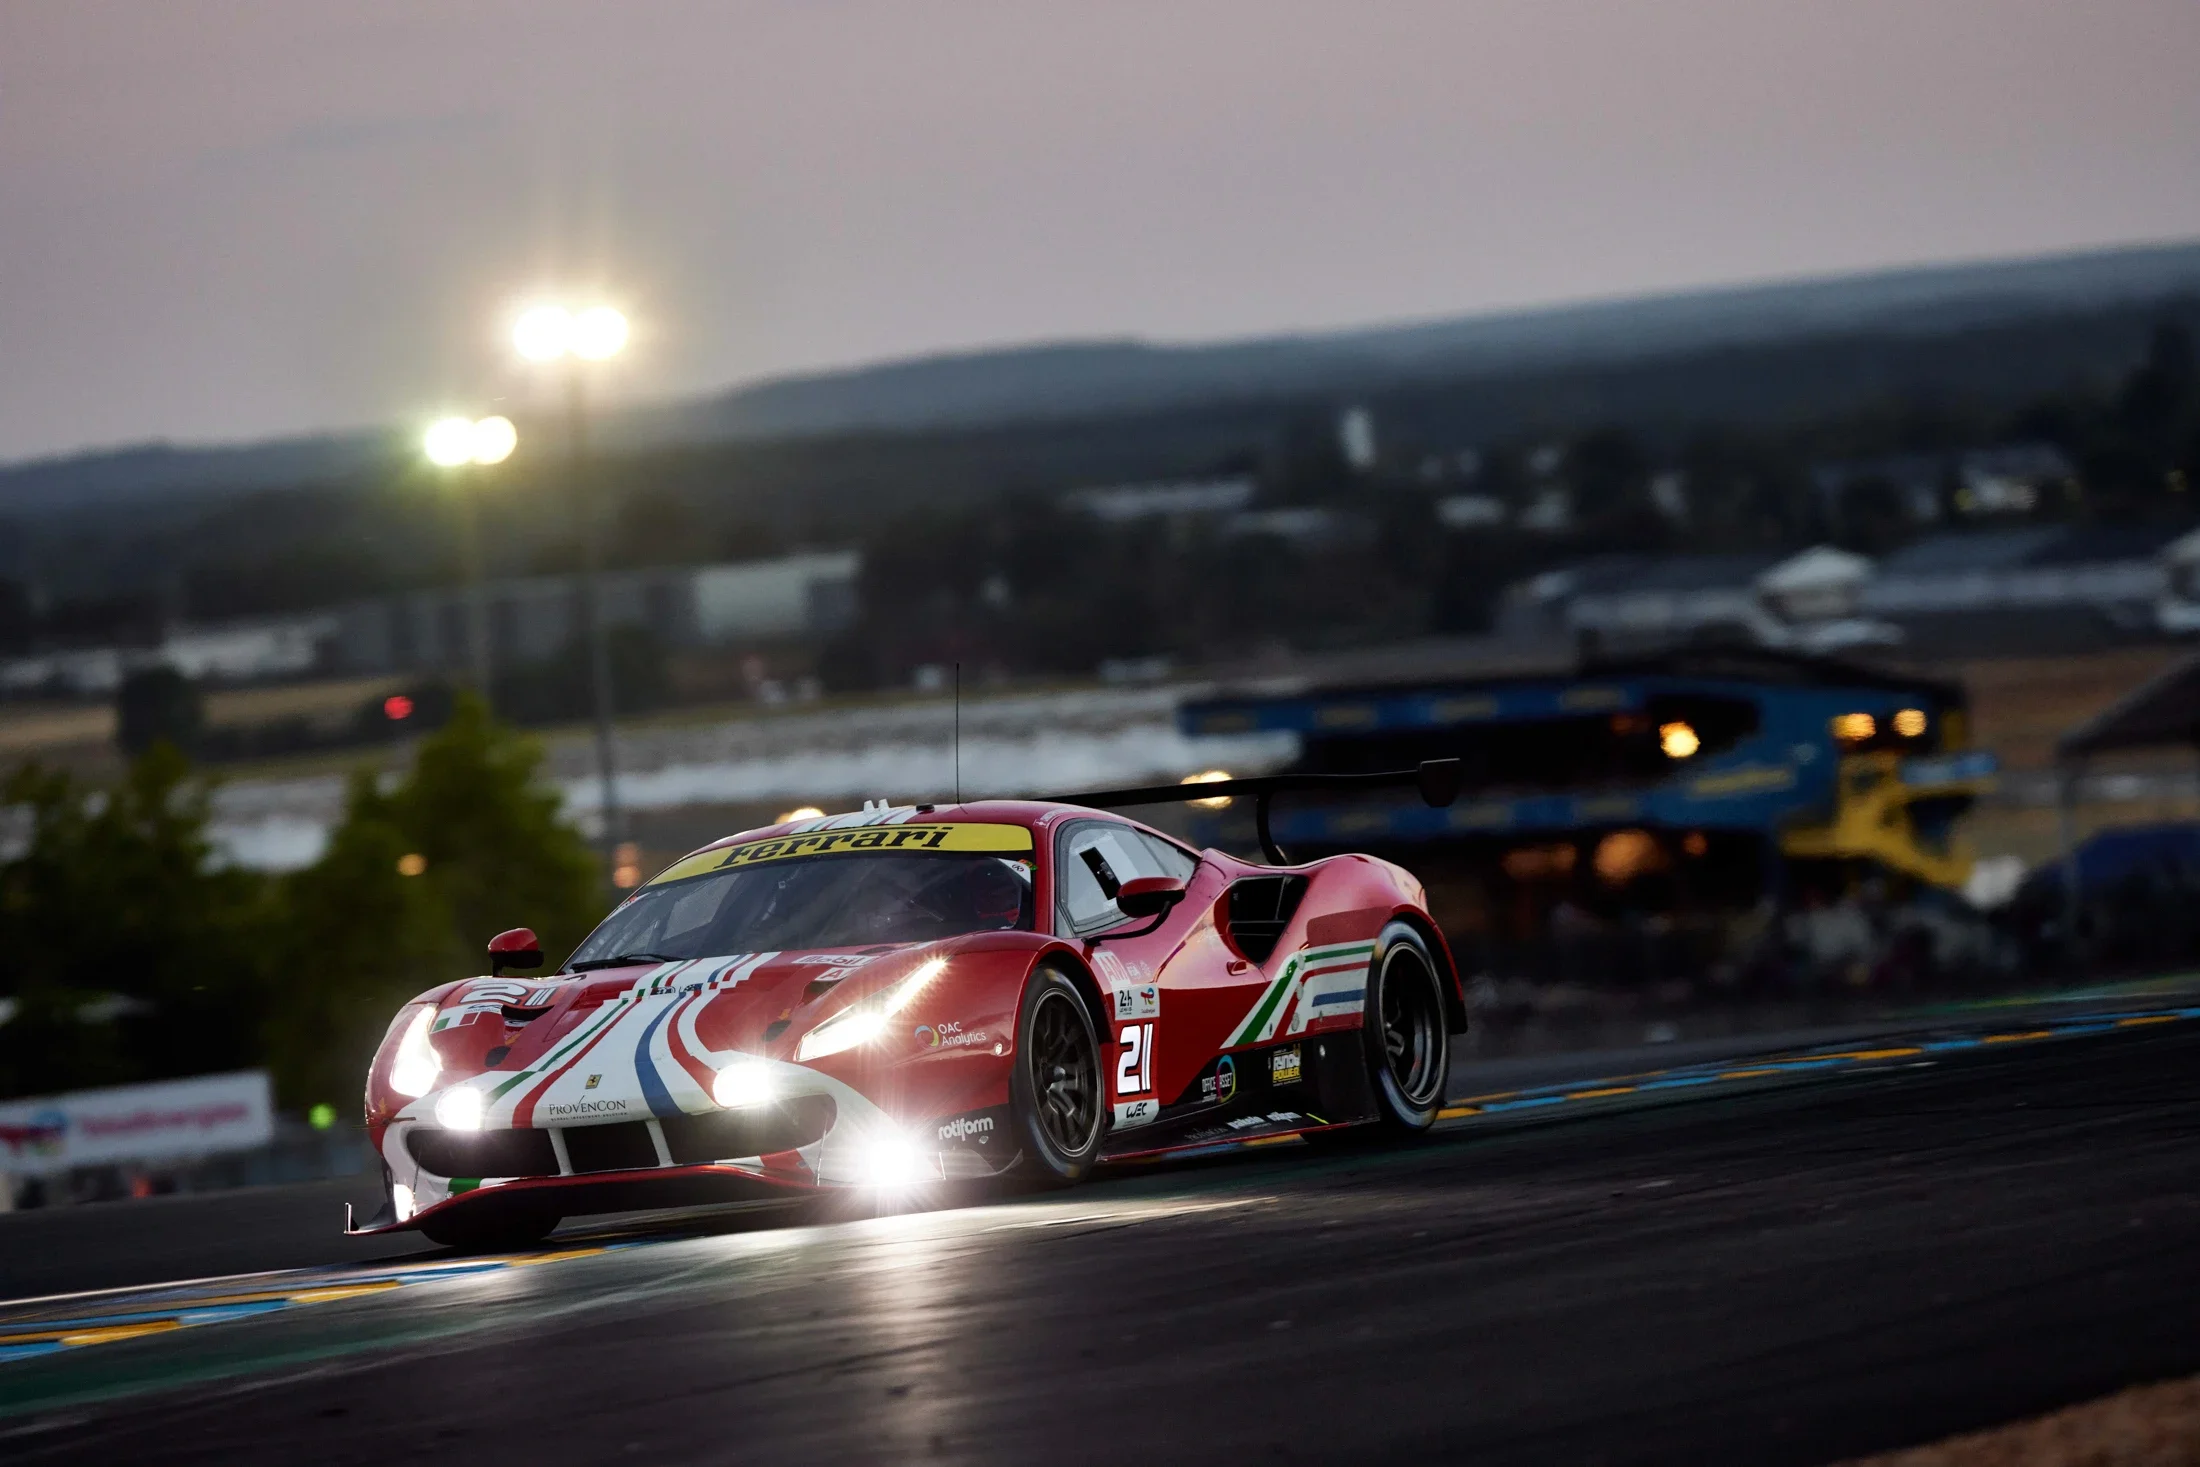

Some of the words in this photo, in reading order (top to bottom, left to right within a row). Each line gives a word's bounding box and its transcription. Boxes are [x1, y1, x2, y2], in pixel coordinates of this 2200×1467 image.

[713, 826, 953, 869] Ferrari
[459, 982, 557, 1007] 21
[938, 1021, 963, 1034] OAC
[942, 1031, 987, 1046] Analytics
[1116, 1022, 1155, 1097] 21
[1272, 1066, 1300, 1080] POWER
[1201, 1075, 1216, 1092] OFFICE
[1125, 1102, 1148, 1119] WEC
[938, 1117, 994, 1141] rotiform
